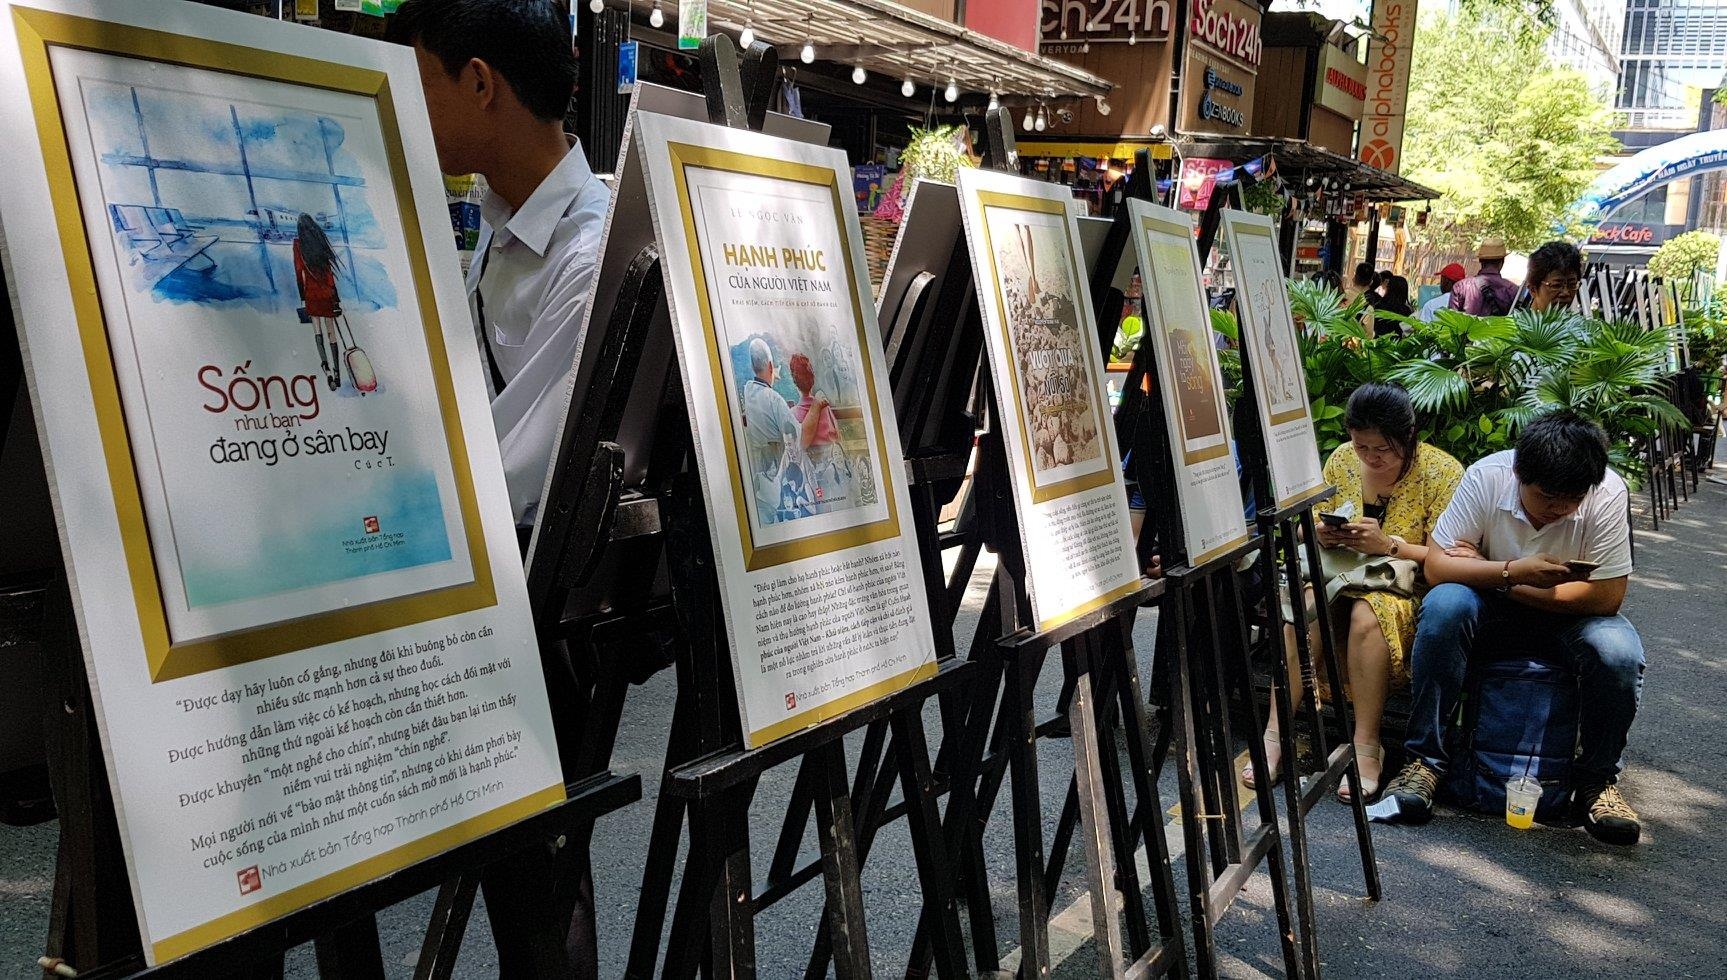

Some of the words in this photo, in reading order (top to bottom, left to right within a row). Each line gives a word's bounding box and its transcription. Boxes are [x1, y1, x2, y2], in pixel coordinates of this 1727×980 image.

[1369, 4, 1401, 137] alphabooks
[723, 243, 779, 271] HẠNH
[782, 244, 826, 271] PHÚC
[1621, 225, 1652, 243] Cafe
[729, 272, 751, 289] CỦA
[752, 275, 787, 291] NGƯỜI
[788, 276, 808, 293] VIỆT
[810, 280, 832, 292] NAM
[197, 360, 320, 420] Sống
[234, 414, 269, 431] như
[272, 412, 301, 429] bạn
[210, 437, 278, 466] đang
[282, 430, 299, 457] ở
[304, 429, 347, 455] sân
[346, 426, 389, 455] bay
[176, 695, 218, 713] “Được
[221, 689, 242, 705] dạy
[245, 683, 267, 701] hãy
[269, 675, 295, 692] luôn
[297, 667, 310, 684] cố
[313, 665, 342, 683] gắng,
[344, 655, 377, 673] nhưng
[379, 649, 396, 663] đôi
[397, 643, 414, 659] khi
[415, 638, 446, 654] buông
[446, 633, 459, 646] bỏ
[460, 630, 477, 643] còn
[292, 690, 311, 705] sức
[313, 680, 344, 700] mạnh
[346, 676, 367, 691] hơn
[369, 671, 381, 684] cả
[382, 669, 394, 682] sự
[397, 664, 418, 677] theo
[420, 655, 444, 671] đuổi.
[168, 744, 204, 763] Được
[207, 733, 247, 753] hướng
[250, 723, 272, 739] dẫn
[274, 719, 296, 734] làm
[298, 712, 321, 727] việc
[323, 705, 336, 718] có
[353, 693, 387, 713] hoạch,
[389, 686, 420, 702] nhưng
[422, 679, 439, 693] học
[441, 670, 462, 686] cách
[463, 665, 478, 680] đối
[480, 662, 497, 676] mặt
[497, 657, 512, 670] với
[241, 745, 281, 764] những
[283, 734, 302, 751] thứ
[305, 726, 335, 746] ngoài
[351, 712, 383, 731] hoạch
[385, 707, 403, 721] còn
[424, 694, 446, 709] thiết
[447, 689, 468, 703] hơn.
[179, 789, 214, 807] Được
[263, 763, 293, 781] “một
[325, 745, 345, 762] cho
[377, 728, 410, 746] nhưng
[411, 720, 430, 735] biết
[432, 714, 449, 729] đâu
[450, 707, 468, 723] bạn
[469, 704, 481, 717] lại
[482, 698, 497, 712] tìm
[499, 692, 517, 708] thấy
[314, 773, 332, 786] vui
[334, 763, 352, 779] trải
[354, 752, 393, 774] nghiệm
[394, 740, 421, 758] “chín
[190, 832, 217, 851] Mọi
[220, 817, 256, 842] người
[324, 790, 346, 806] mật
[347, 780, 382, 798] thông
[401, 762, 433, 779] nhưng
[434, 756, 446, 768] có
[448, 748, 463, 764] khi
[485, 735, 506, 752] phơi
[507, 729, 522, 744] bày
[203, 850, 233, 868] cuộc
[236, 837, 266, 858] sống
[266, 829, 288, 846] của
[290, 817, 320, 838] mình
[322, 809, 346, 826] như
[347, 801, 369, 818] một
[370, 793, 396, 809] cuốn
[397, 781, 420, 799] sách
[421, 776, 437, 791] mở
[439, 768, 458, 783] mới
[459, 764, 468, 777] là
[469, 755, 491, 774] hạnh
[261, 861, 287, 879] Nhà
[290, 849, 317, 868] xuất
[318, 841, 341, 859] bản
[343, 830, 372, 848] Tổng
[373, 822, 394, 840] hợp
[395, 808, 428, 825] Thành
[430, 798, 449, 817] phố
[451, 795, 465, 808] Hồ
[465, 788, 481, 801] Chí
[482, 780, 504, 796] Minh
